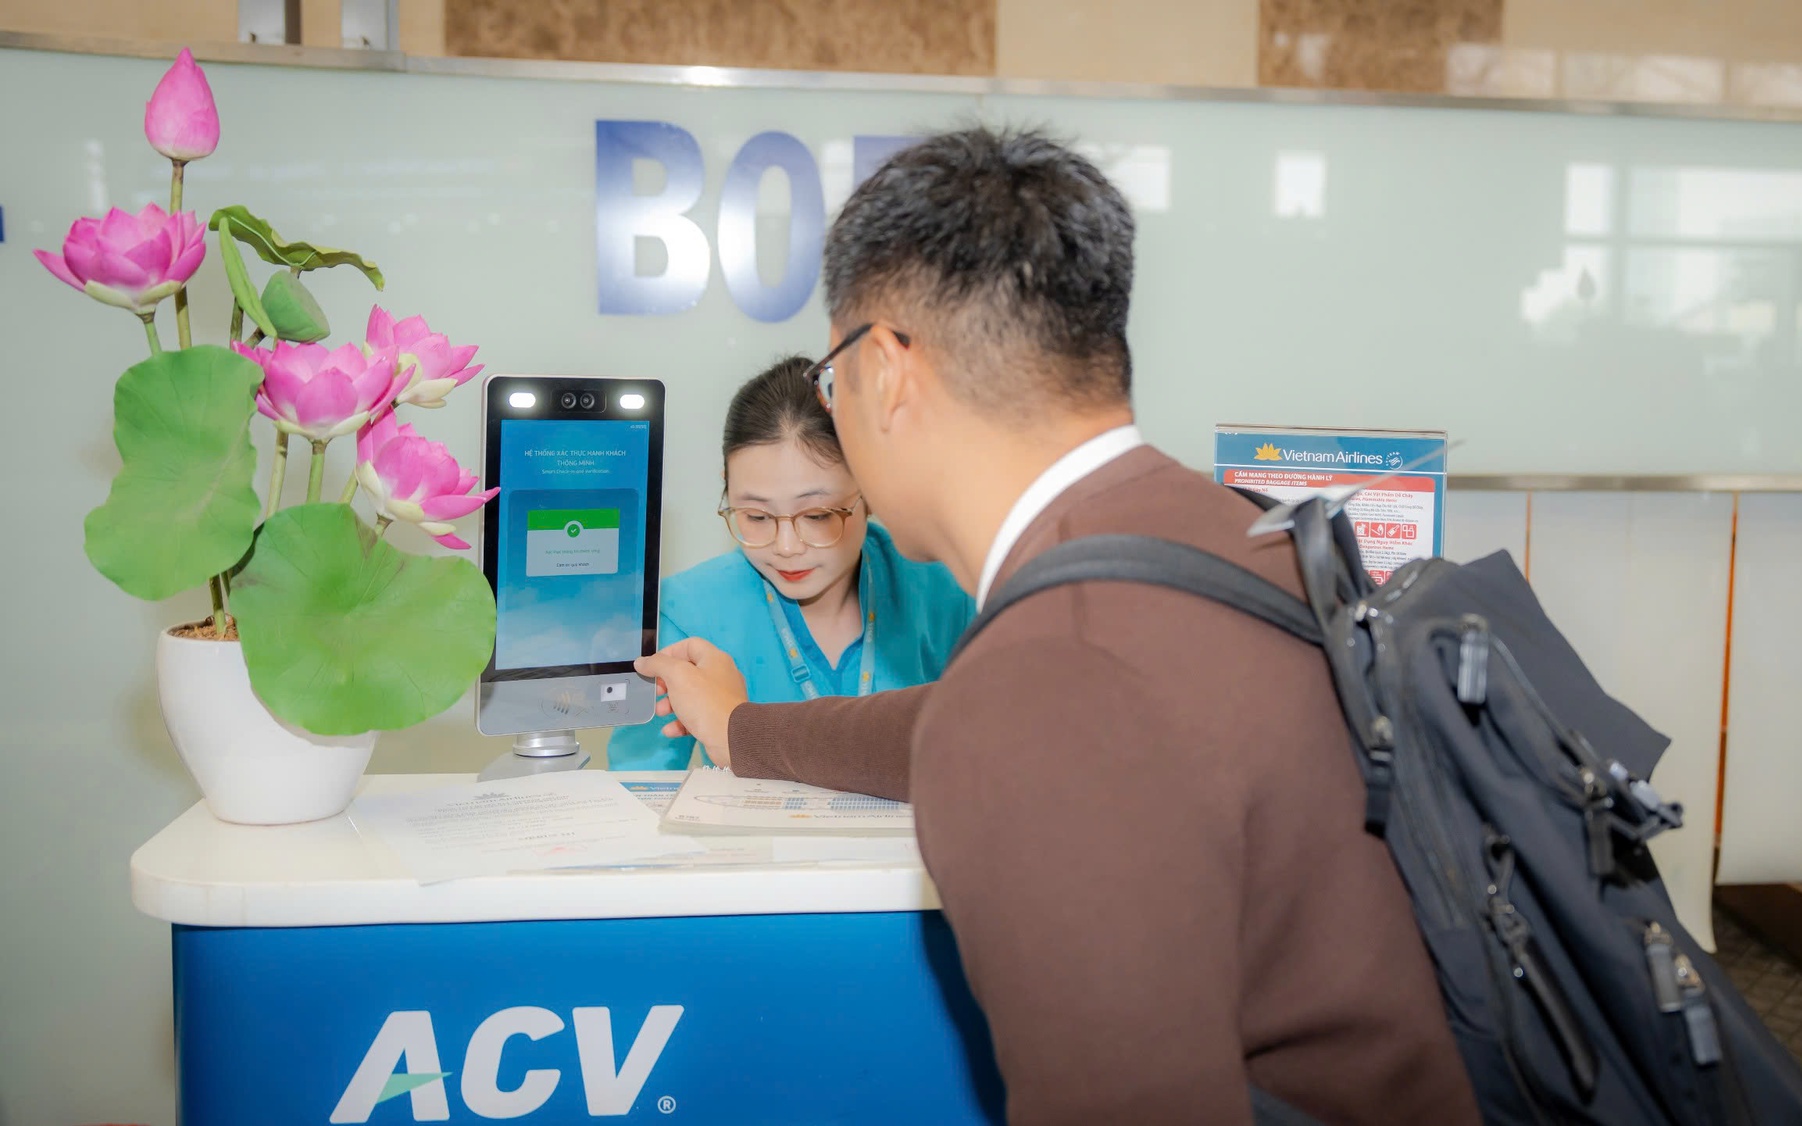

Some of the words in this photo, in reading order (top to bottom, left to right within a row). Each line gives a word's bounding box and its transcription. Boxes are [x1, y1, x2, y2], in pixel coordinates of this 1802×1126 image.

[596, 119, 922, 323] BO
[1282, 449, 1335, 463] Vietnam
[1336, 451, 1383, 465] Airlines
[329, 1004, 685, 1124] ACV
